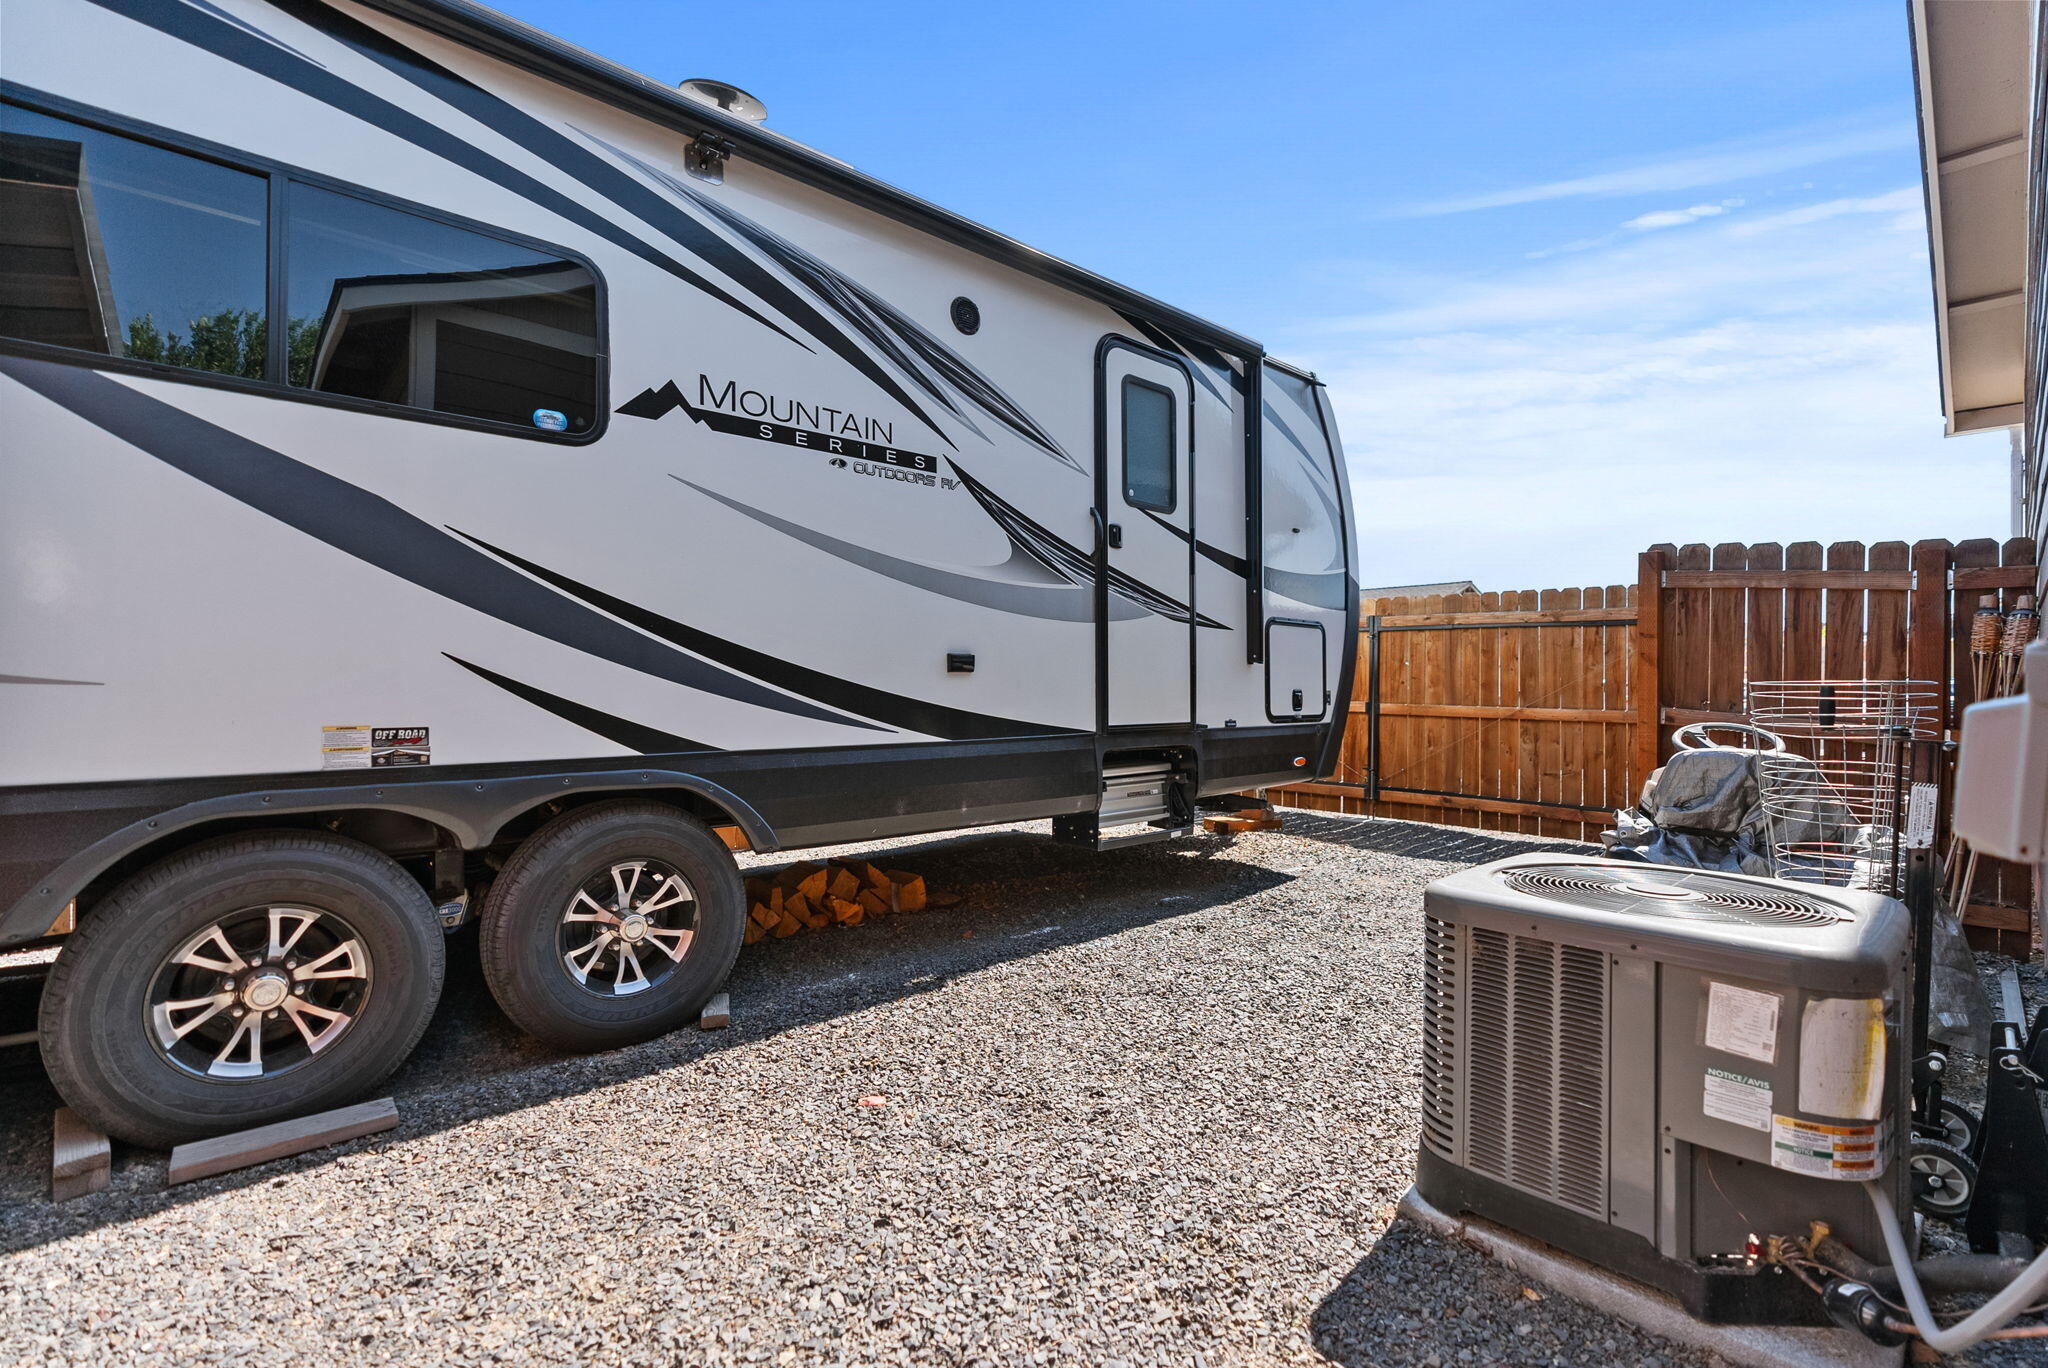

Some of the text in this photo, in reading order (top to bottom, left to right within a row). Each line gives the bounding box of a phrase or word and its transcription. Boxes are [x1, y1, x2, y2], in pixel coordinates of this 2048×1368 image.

[759, 425, 926, 468] SERIES
[853, 461, 961, 490] OUTDOORS RV
[375, 729, 426, 740] OFF ROAD
[1707, 1067, 1770, 1090] NOTICE/AVIS
